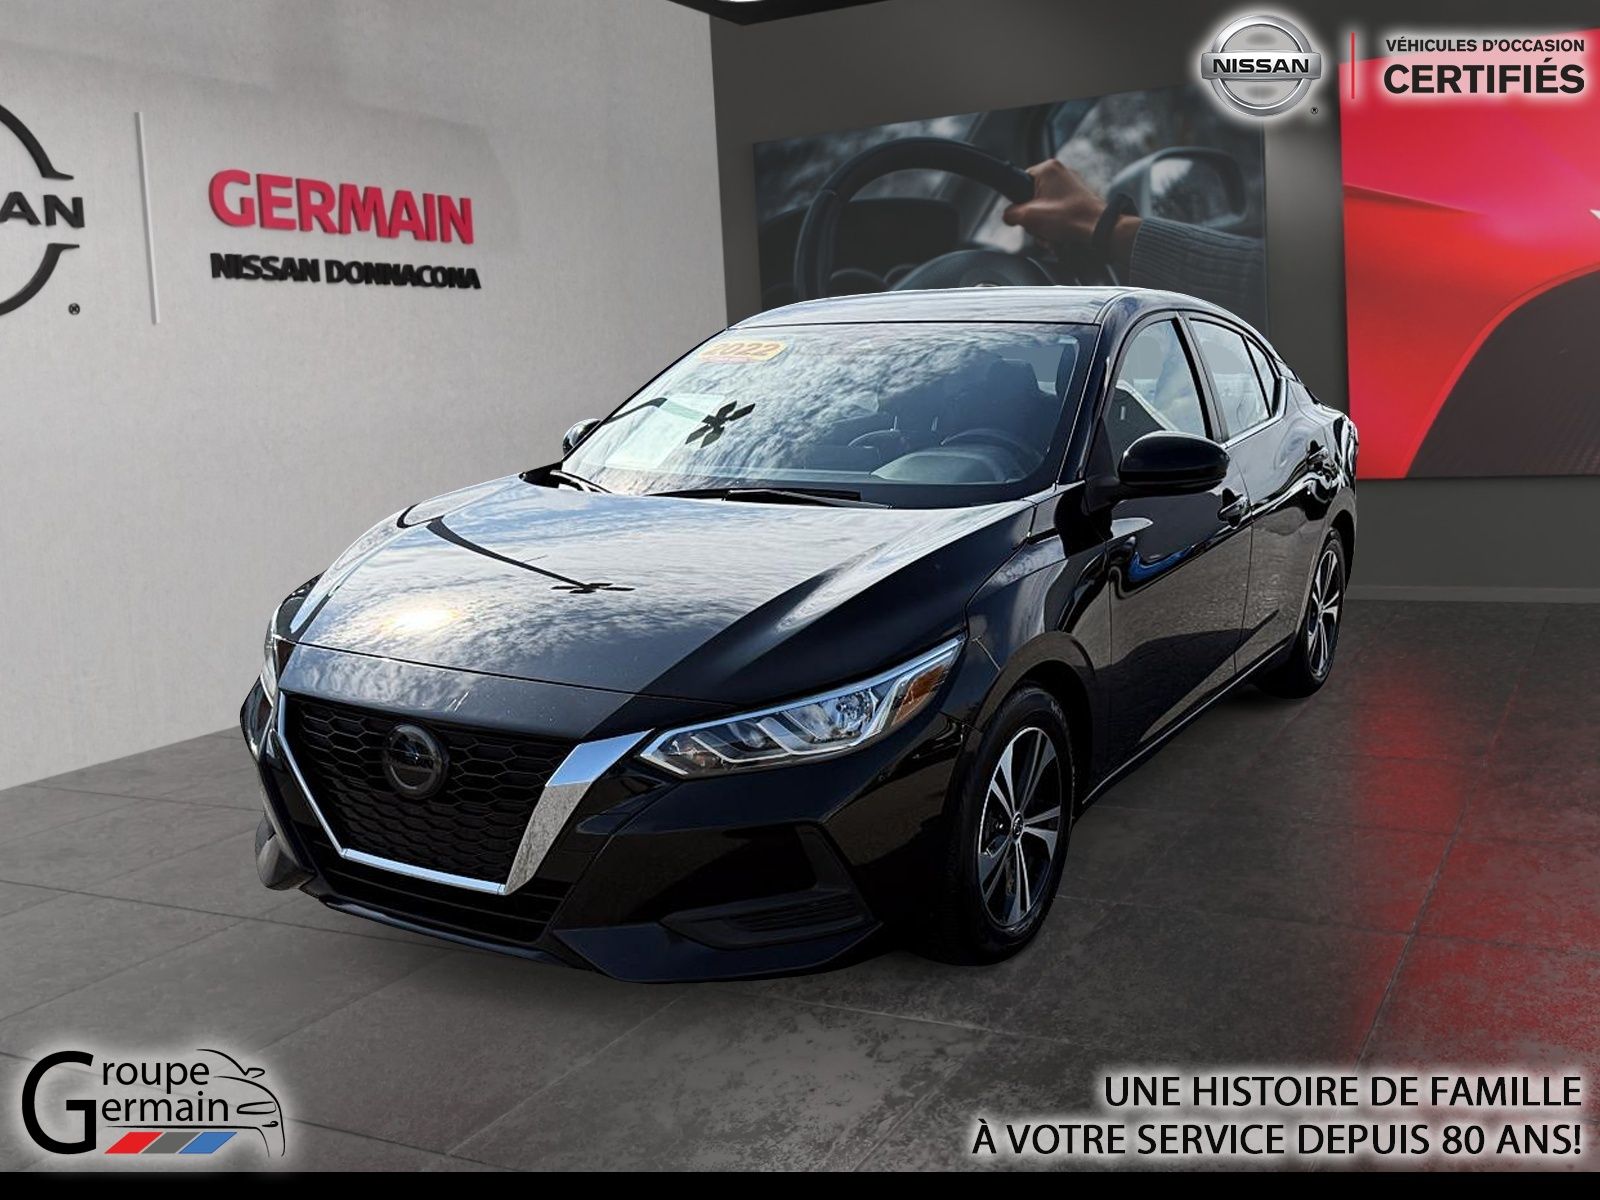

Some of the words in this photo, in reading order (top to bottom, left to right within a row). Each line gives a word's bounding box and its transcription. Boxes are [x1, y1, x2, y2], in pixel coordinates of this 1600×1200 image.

[209, 169, 474, 244] GERMAIN
[210, 253, 320, 283] NISSAN
[325, 259, 481, 289] DONNACONA
[700, 342, 781, 357] 2022
